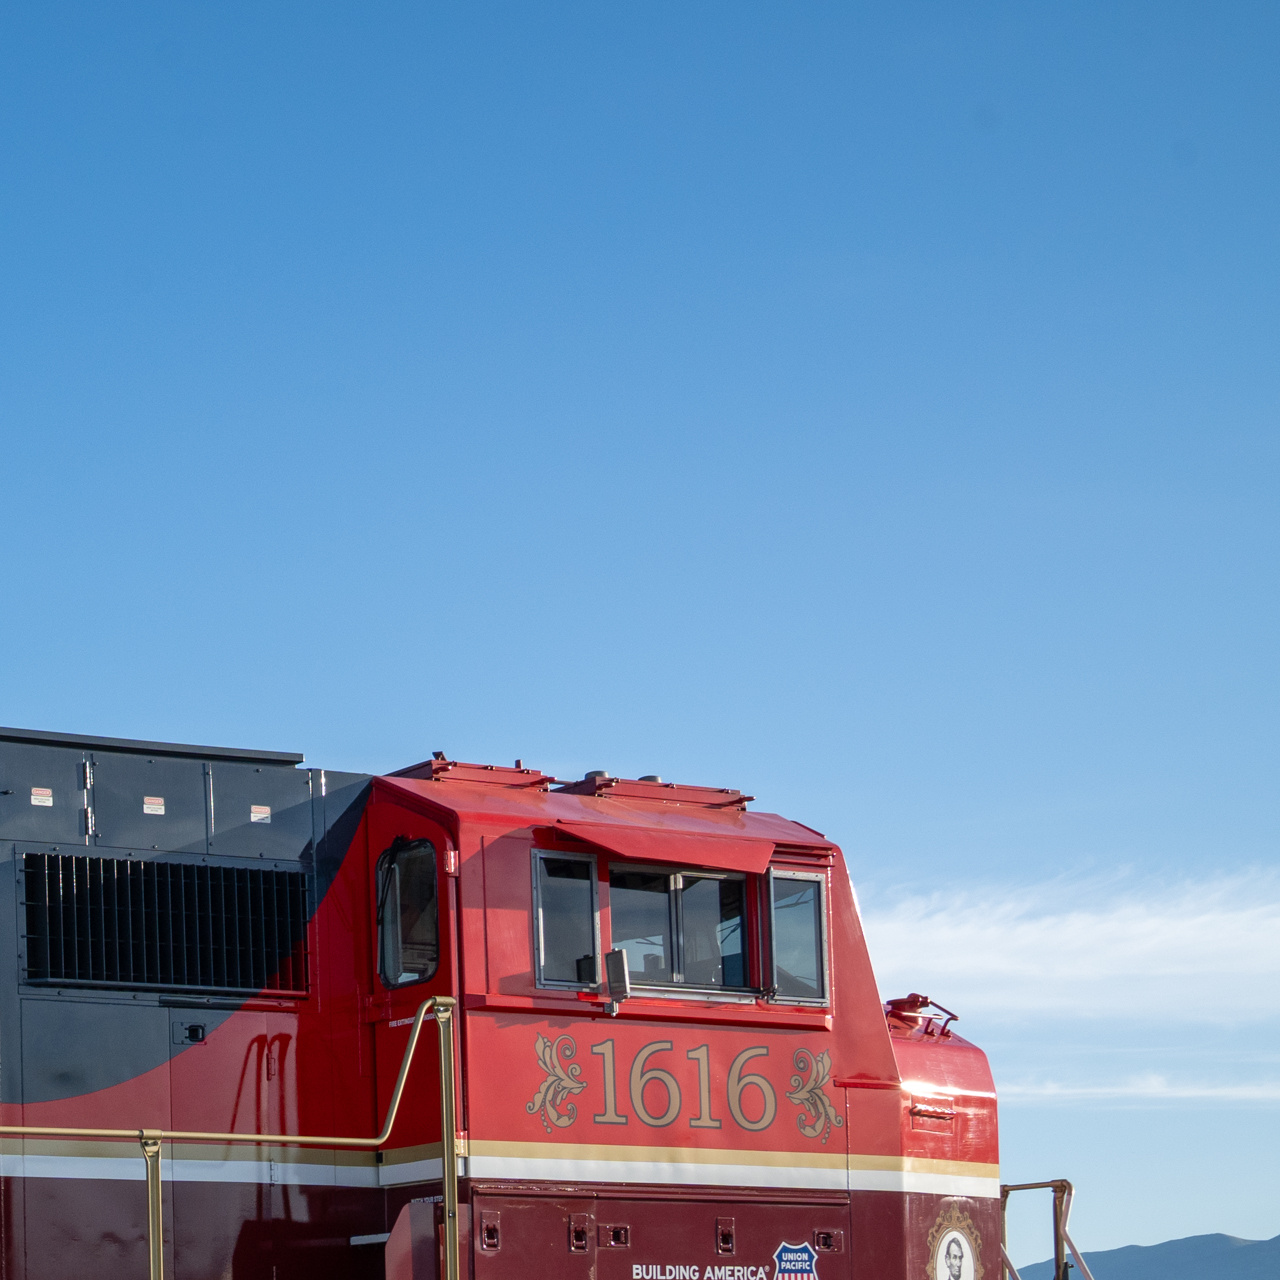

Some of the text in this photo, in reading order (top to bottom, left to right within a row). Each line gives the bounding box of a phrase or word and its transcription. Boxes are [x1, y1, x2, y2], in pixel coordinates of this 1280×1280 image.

[591, 1039, 778, 1131] 1616
[782, 1253, 809, 1261] UNION
[781, 1261, 811, 1270] PACIFIC
[632, 1264, 700, 1280] BUILDING
